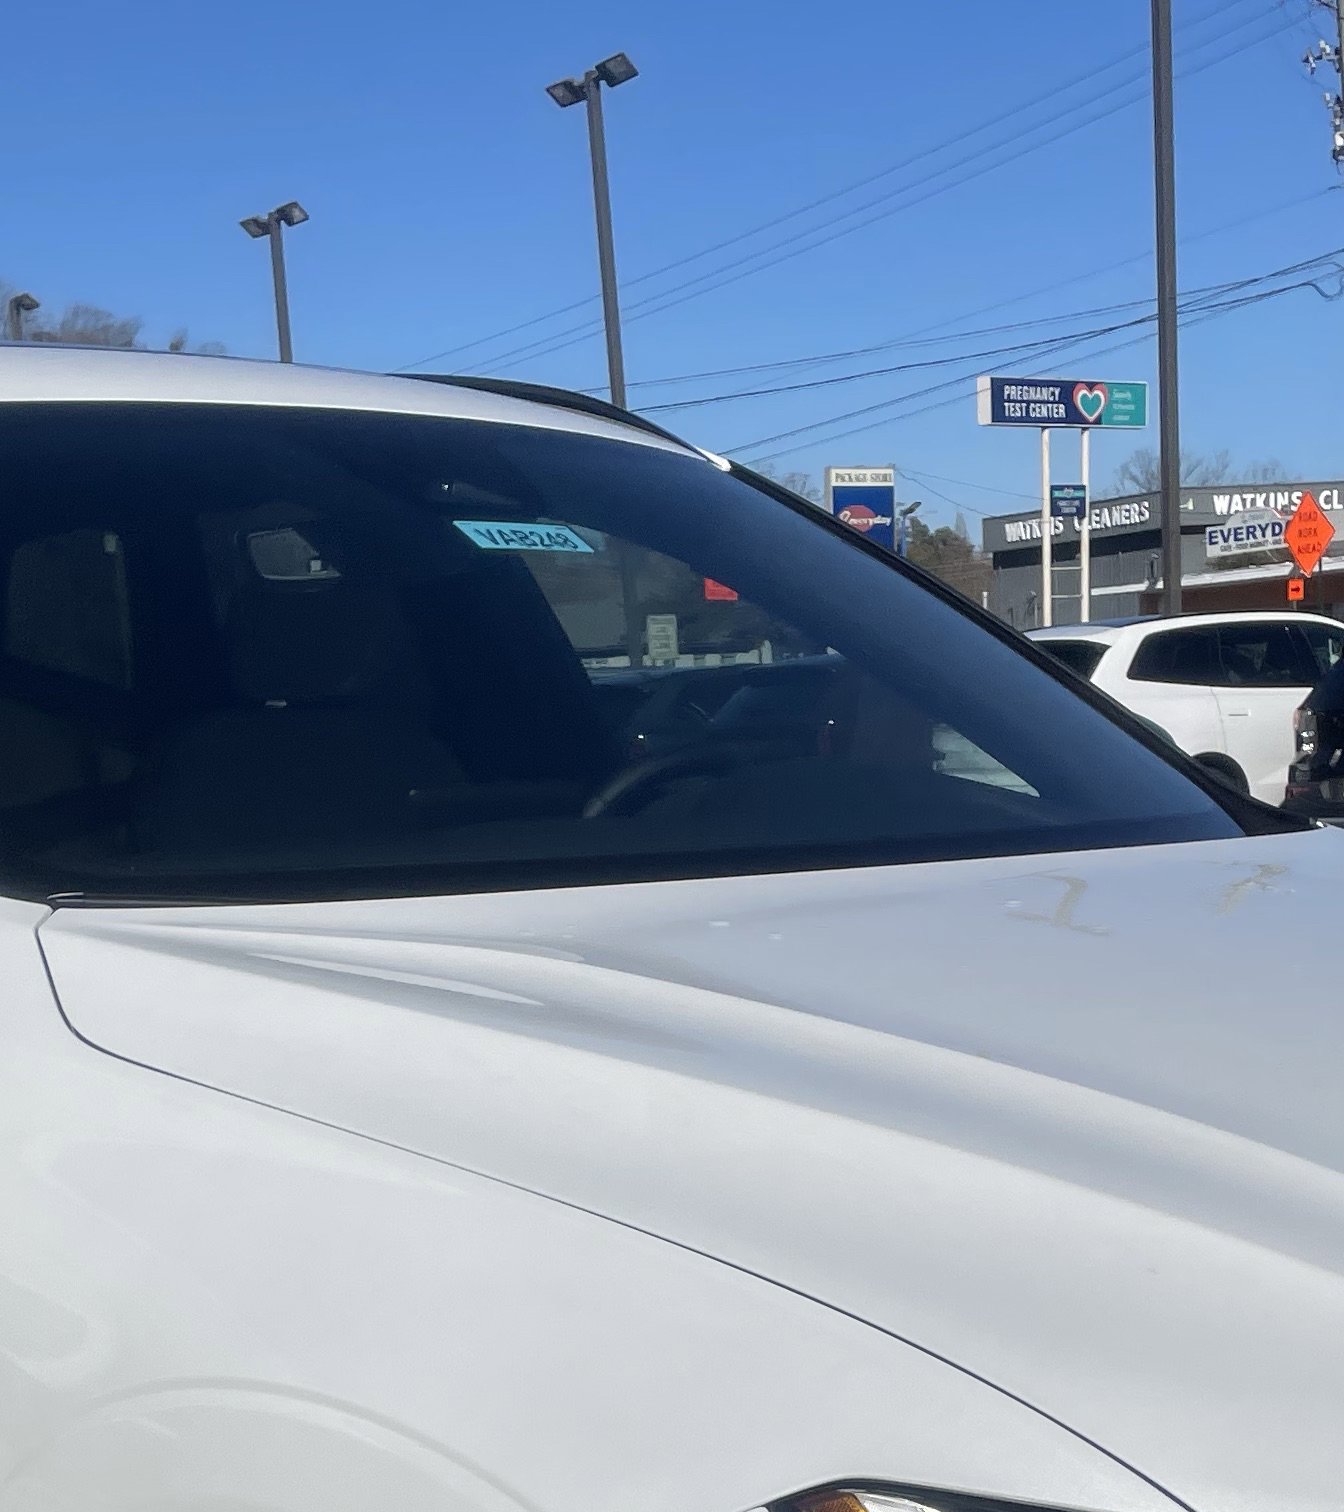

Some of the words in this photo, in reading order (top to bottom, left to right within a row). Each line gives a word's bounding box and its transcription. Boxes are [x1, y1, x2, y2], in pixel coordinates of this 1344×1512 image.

[1003, 384, 1062, 401] PREGNANCY
[1003, 402, 1027, 418] TEST
[1029, 403, 1066, 419] CENTER
[1212, 490, 1302, 515] WATKINS
[1004, 515, 1064, 543] WATKS
[1072, 501, 1150, 532] CEANERS
[1208, 521, 1283, 545] EVERYD
